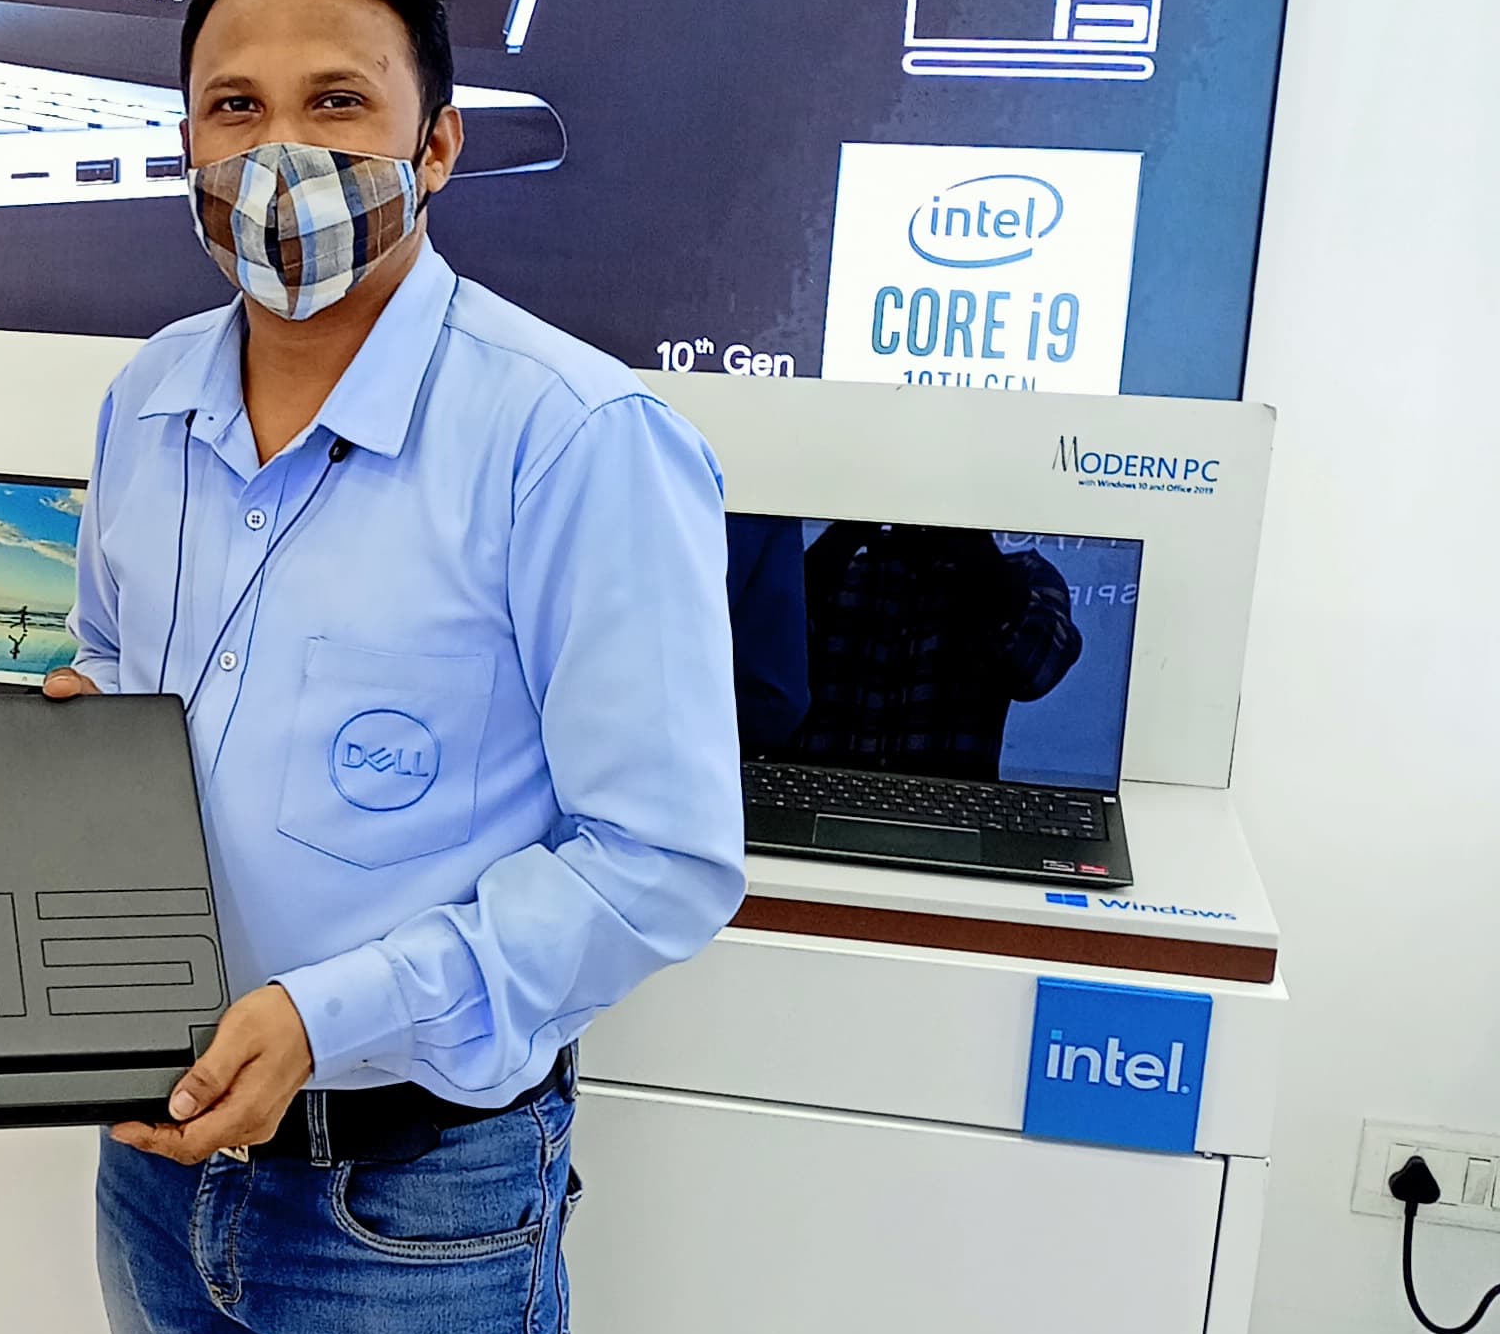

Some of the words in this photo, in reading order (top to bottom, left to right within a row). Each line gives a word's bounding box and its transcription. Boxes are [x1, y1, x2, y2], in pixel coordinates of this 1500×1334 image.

[931, 196, 1035, 238] intel
[872, 286, 1011, 359] CORE
[1027, 292, 1080, 363] i9
[656, 337, 715, 373] 10th
[723, 344, 795, 378] Gen
[1052, 435, 1178, 479] MODERN
[1183, 458, 1220, 483] PC
[1097, 479, 1136, 490] Windows
[342, 743, 429, 778] DELL
[1098, 898, 1237, 921] Windows
